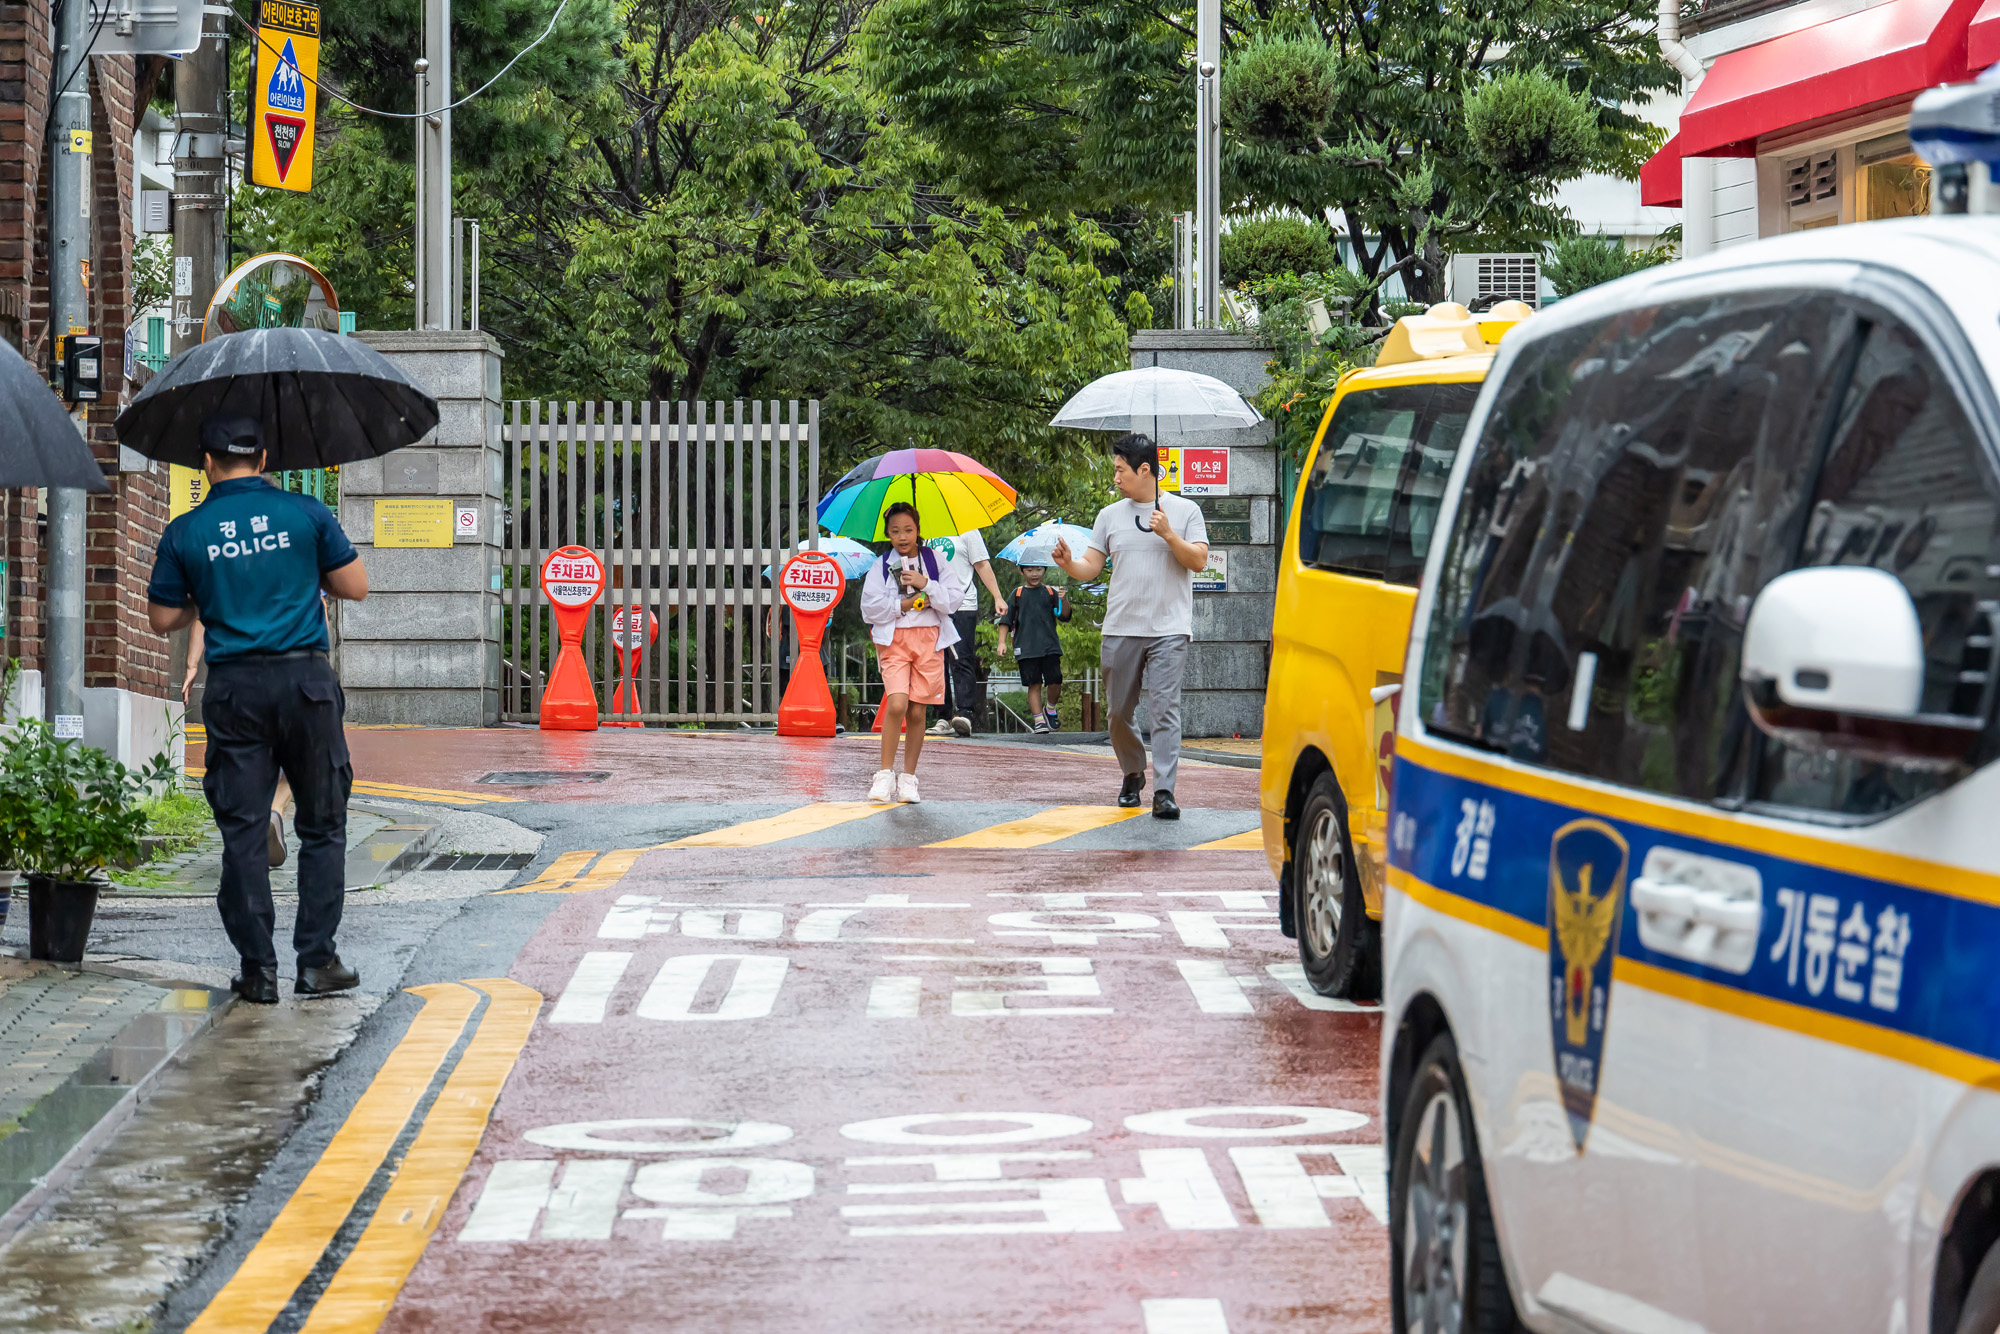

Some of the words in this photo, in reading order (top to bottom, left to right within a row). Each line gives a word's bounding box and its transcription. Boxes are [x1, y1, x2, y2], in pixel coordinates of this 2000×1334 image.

[262, 1, 319, 32] 어린이보호구역
[270, 91, 303, 109] 어린이보호
[274, 124, 296, 141] 천천히
[277, 139, 291, 149] SLOW
[1191, 461, 1221, 473] 에스원
[207, 531, 291, 562] POLICE
[551, 563, 595, 579] 주차금지
[790, 569, 834, 585] 주차금지
[553, 585, 592, 597] 서울연신초등학교
[792, 591, 831, 603] 서울연신초등학교
[616, 617, 642, 629] 주금
[1450, 797, 1496, 881] 경찰
[1769, 888, 1912, 1013] 기동순찰
